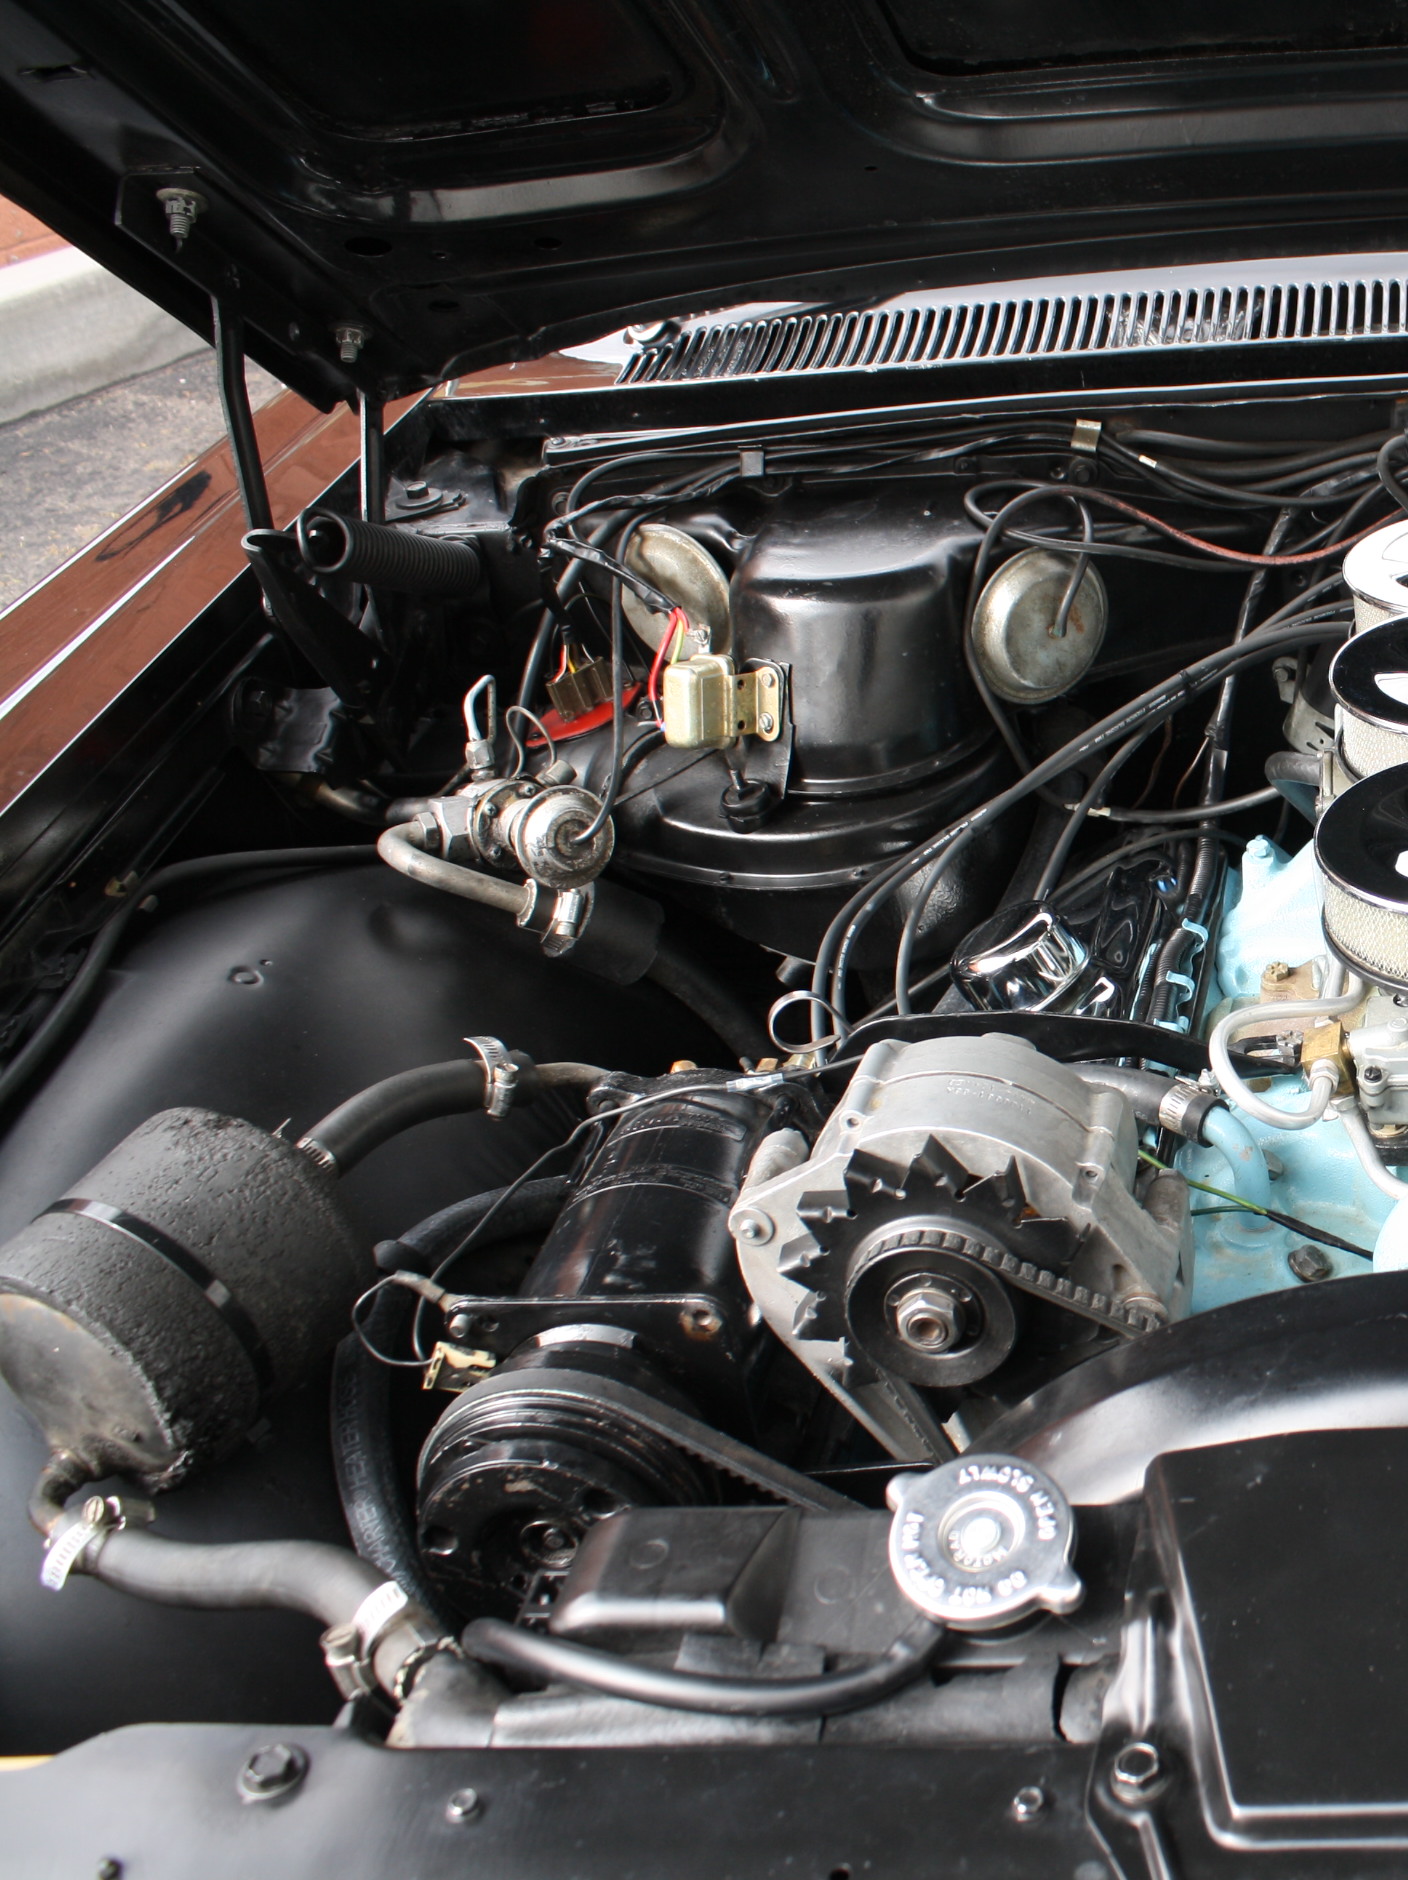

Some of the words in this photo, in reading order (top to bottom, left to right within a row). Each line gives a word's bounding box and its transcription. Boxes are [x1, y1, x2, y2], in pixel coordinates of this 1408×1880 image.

[340, 1421, 368, 1490] HEATER
[958, 1465, 1034, 1492] SLOWLY
[1030, 1490, 1057, 1541] OPEN
